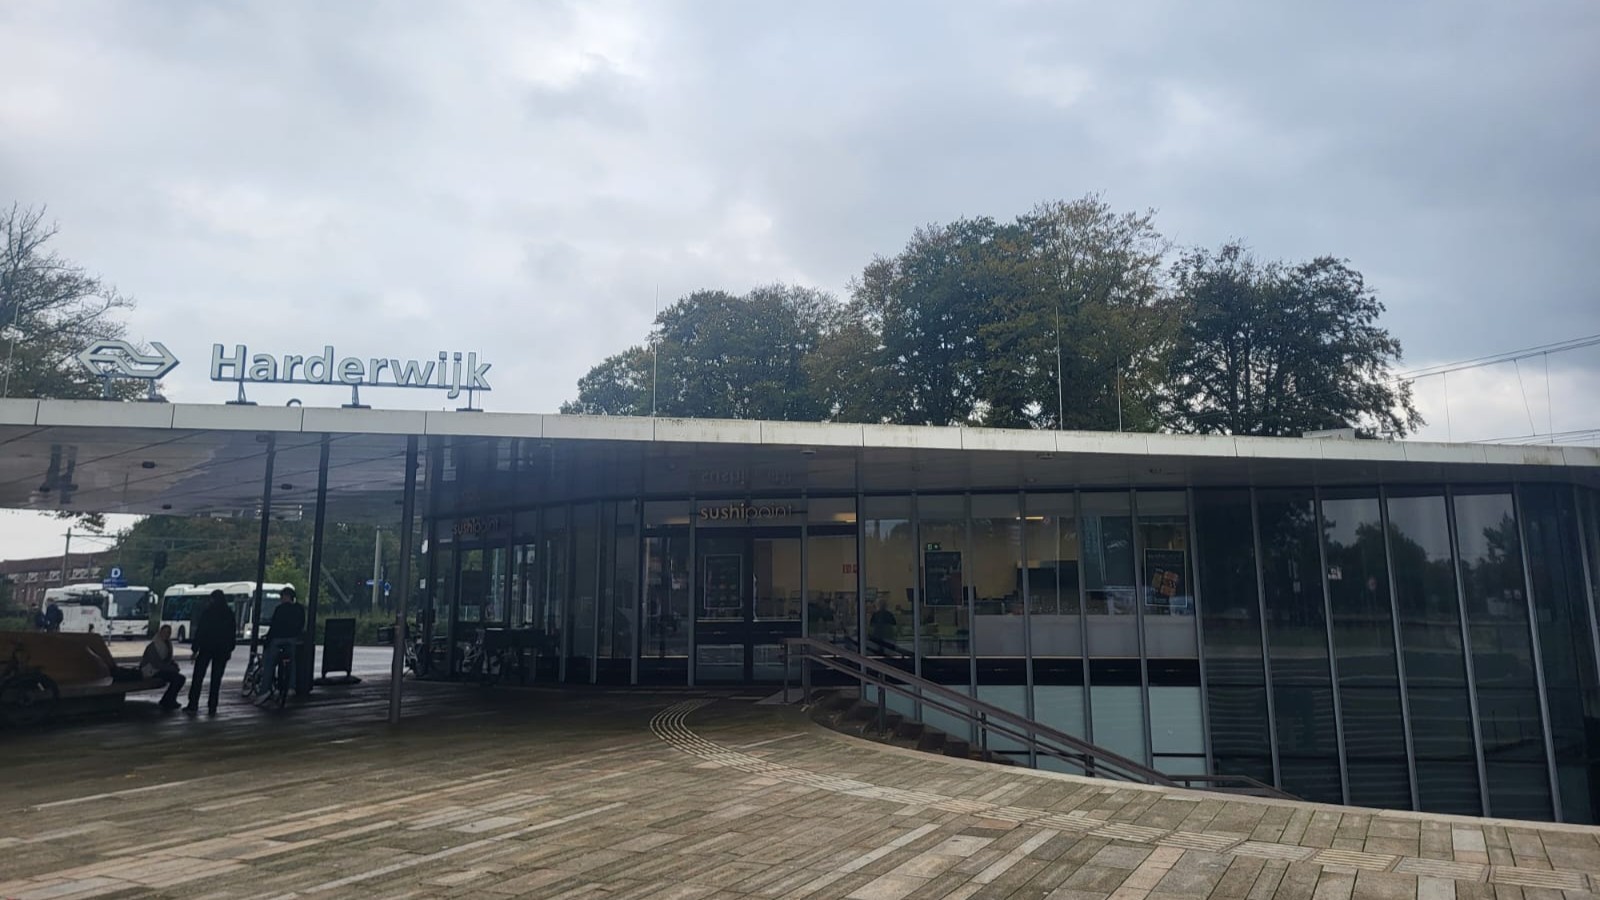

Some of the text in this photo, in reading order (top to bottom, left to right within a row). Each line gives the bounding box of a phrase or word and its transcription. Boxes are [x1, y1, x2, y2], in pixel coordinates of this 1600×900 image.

[211, 344, 492, 399] Harderwijk
[700, 503, 792, 522] sushipoint
[111, 568, 121, 578] D
